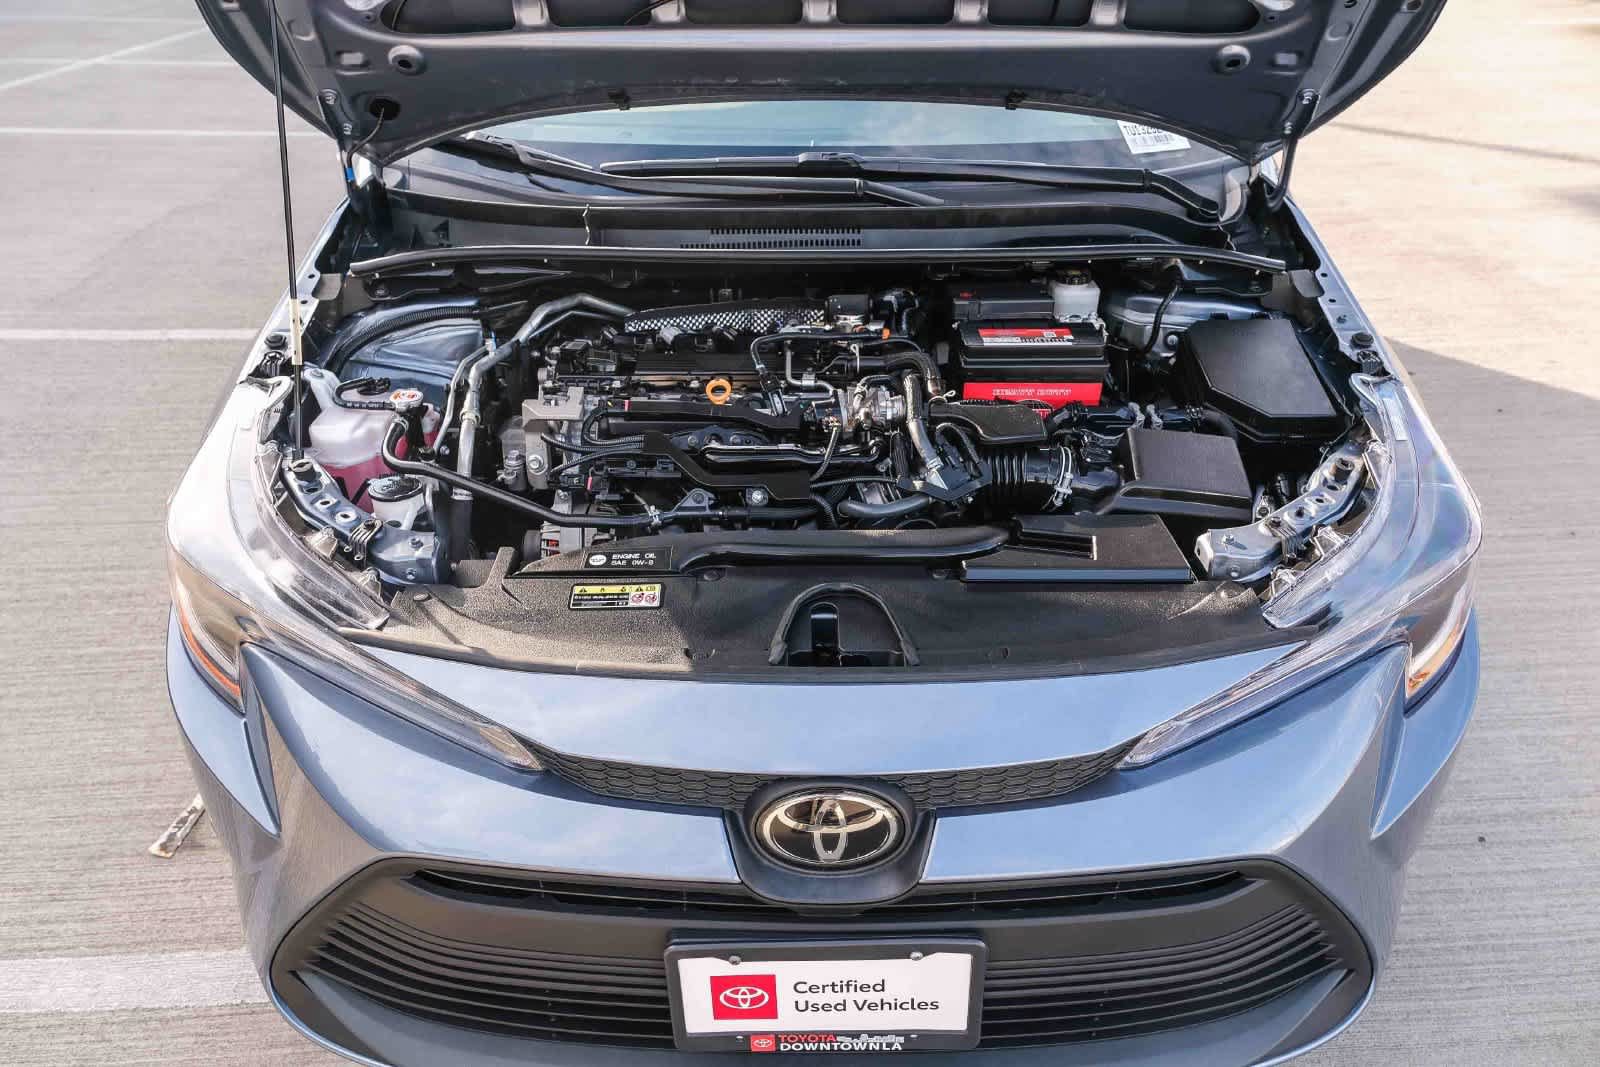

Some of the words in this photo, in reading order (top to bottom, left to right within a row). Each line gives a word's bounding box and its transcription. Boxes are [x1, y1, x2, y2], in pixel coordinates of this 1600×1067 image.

[793, 979, 886, 994] Certified
[794, 999, 847, 1012] Used
[853, 997, 940, 1011] Vehicles
[778, 1034, 837, 1043] TOYOTA
